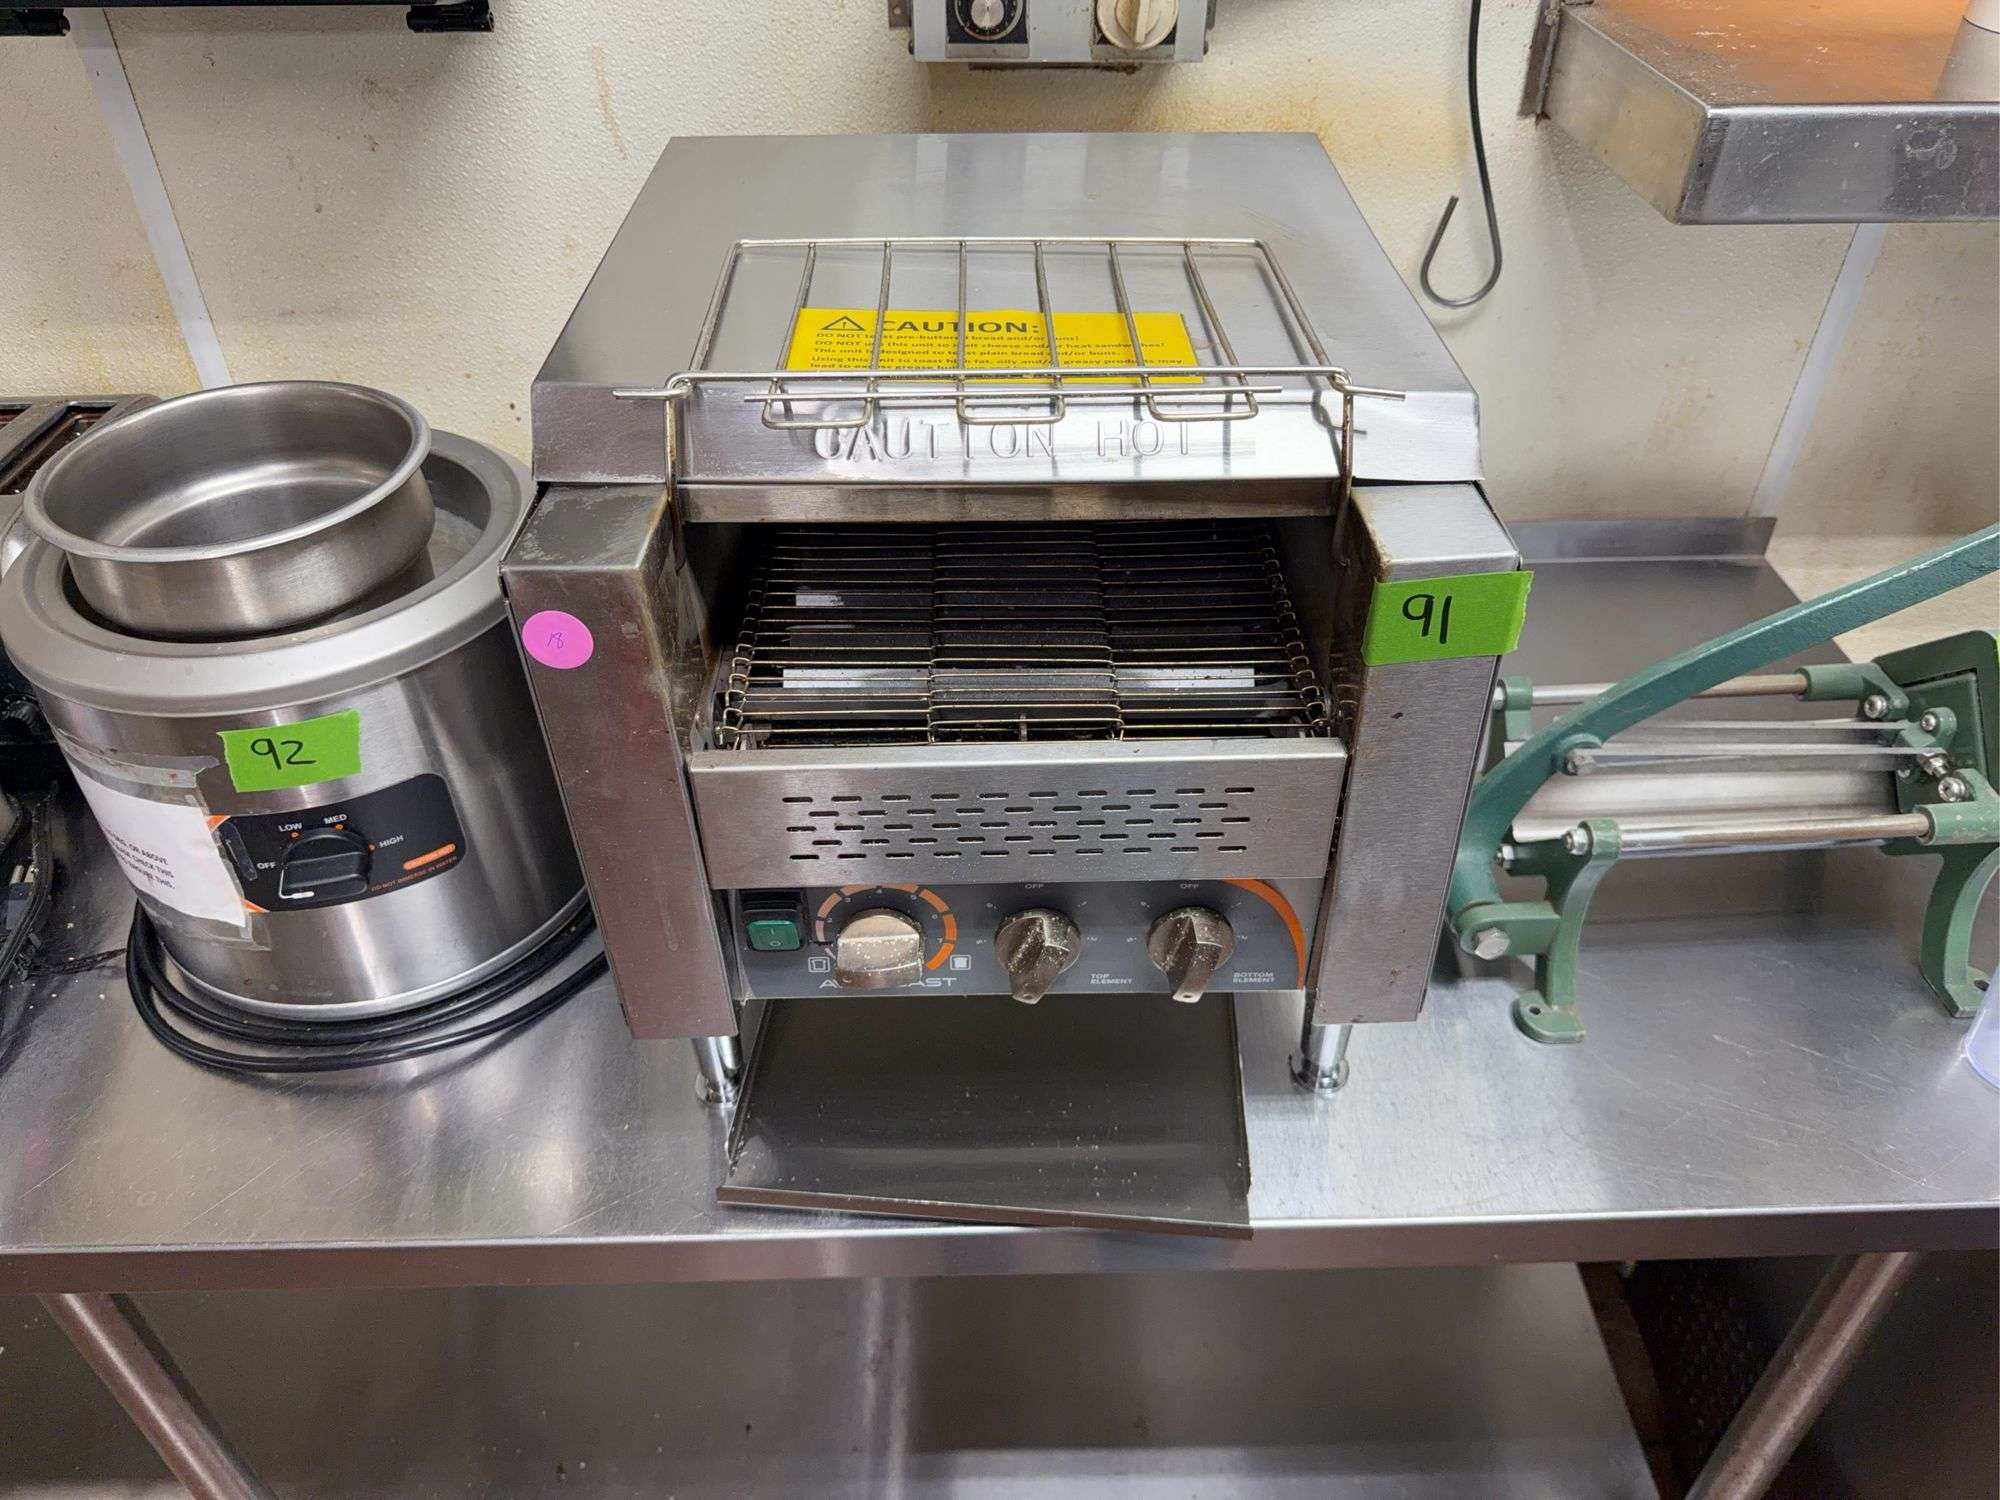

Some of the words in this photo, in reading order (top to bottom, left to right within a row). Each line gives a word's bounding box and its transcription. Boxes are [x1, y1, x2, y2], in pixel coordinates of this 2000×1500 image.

[880, 320, 1040, 333] CAUTION:
[814, 414, 1057, 463] CAUTION
[1402, 593, 1453, 645] 91
[250, 738, 317, 770] 92
[323, 813, 348, 825] MED
[278, 822, 303, 832] LOW
[379, 834, 405, 849] HIGH
[256, 861, 277, 870] OFF
